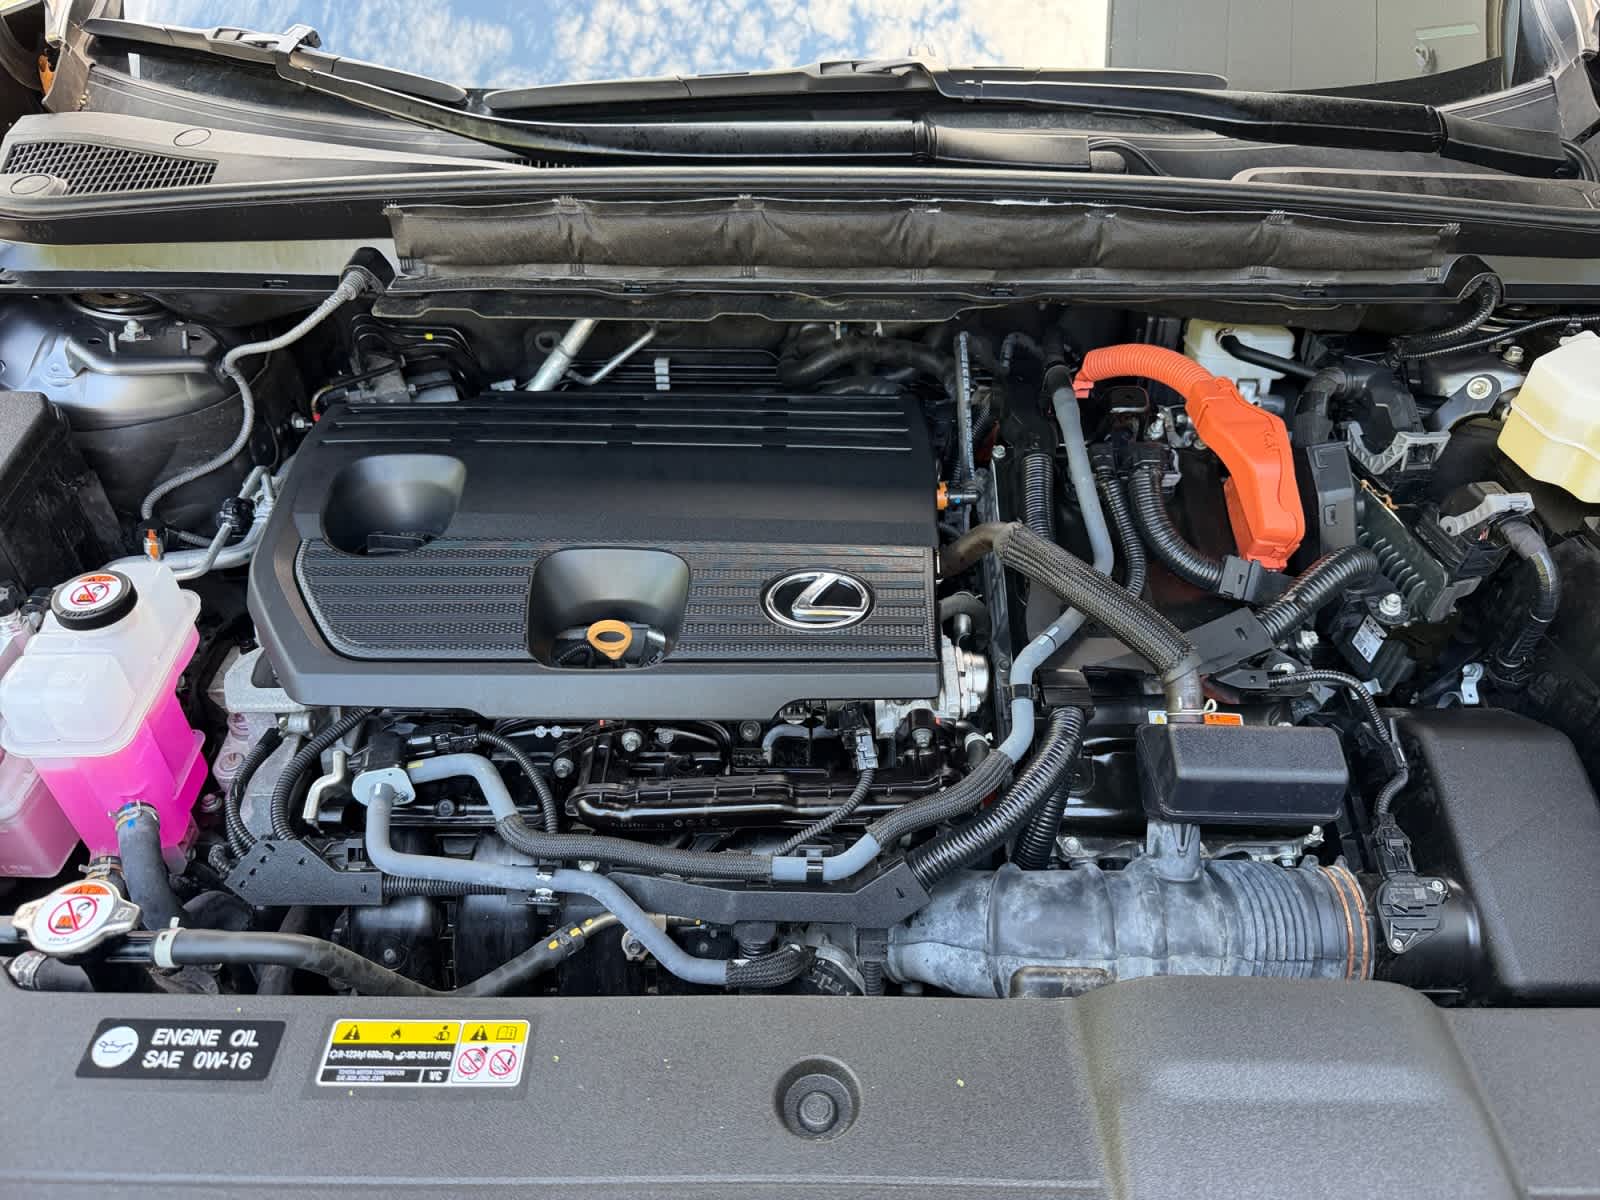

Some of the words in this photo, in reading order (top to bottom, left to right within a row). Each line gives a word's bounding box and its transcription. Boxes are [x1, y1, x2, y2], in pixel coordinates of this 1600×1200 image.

[151, 1028, 222, 1046] ENGINE
[229, 1029, 259, 1047] OIL
[142, 1050, 184, 1069] SAE
[192, 1051, 253, 1070] 0W-16
